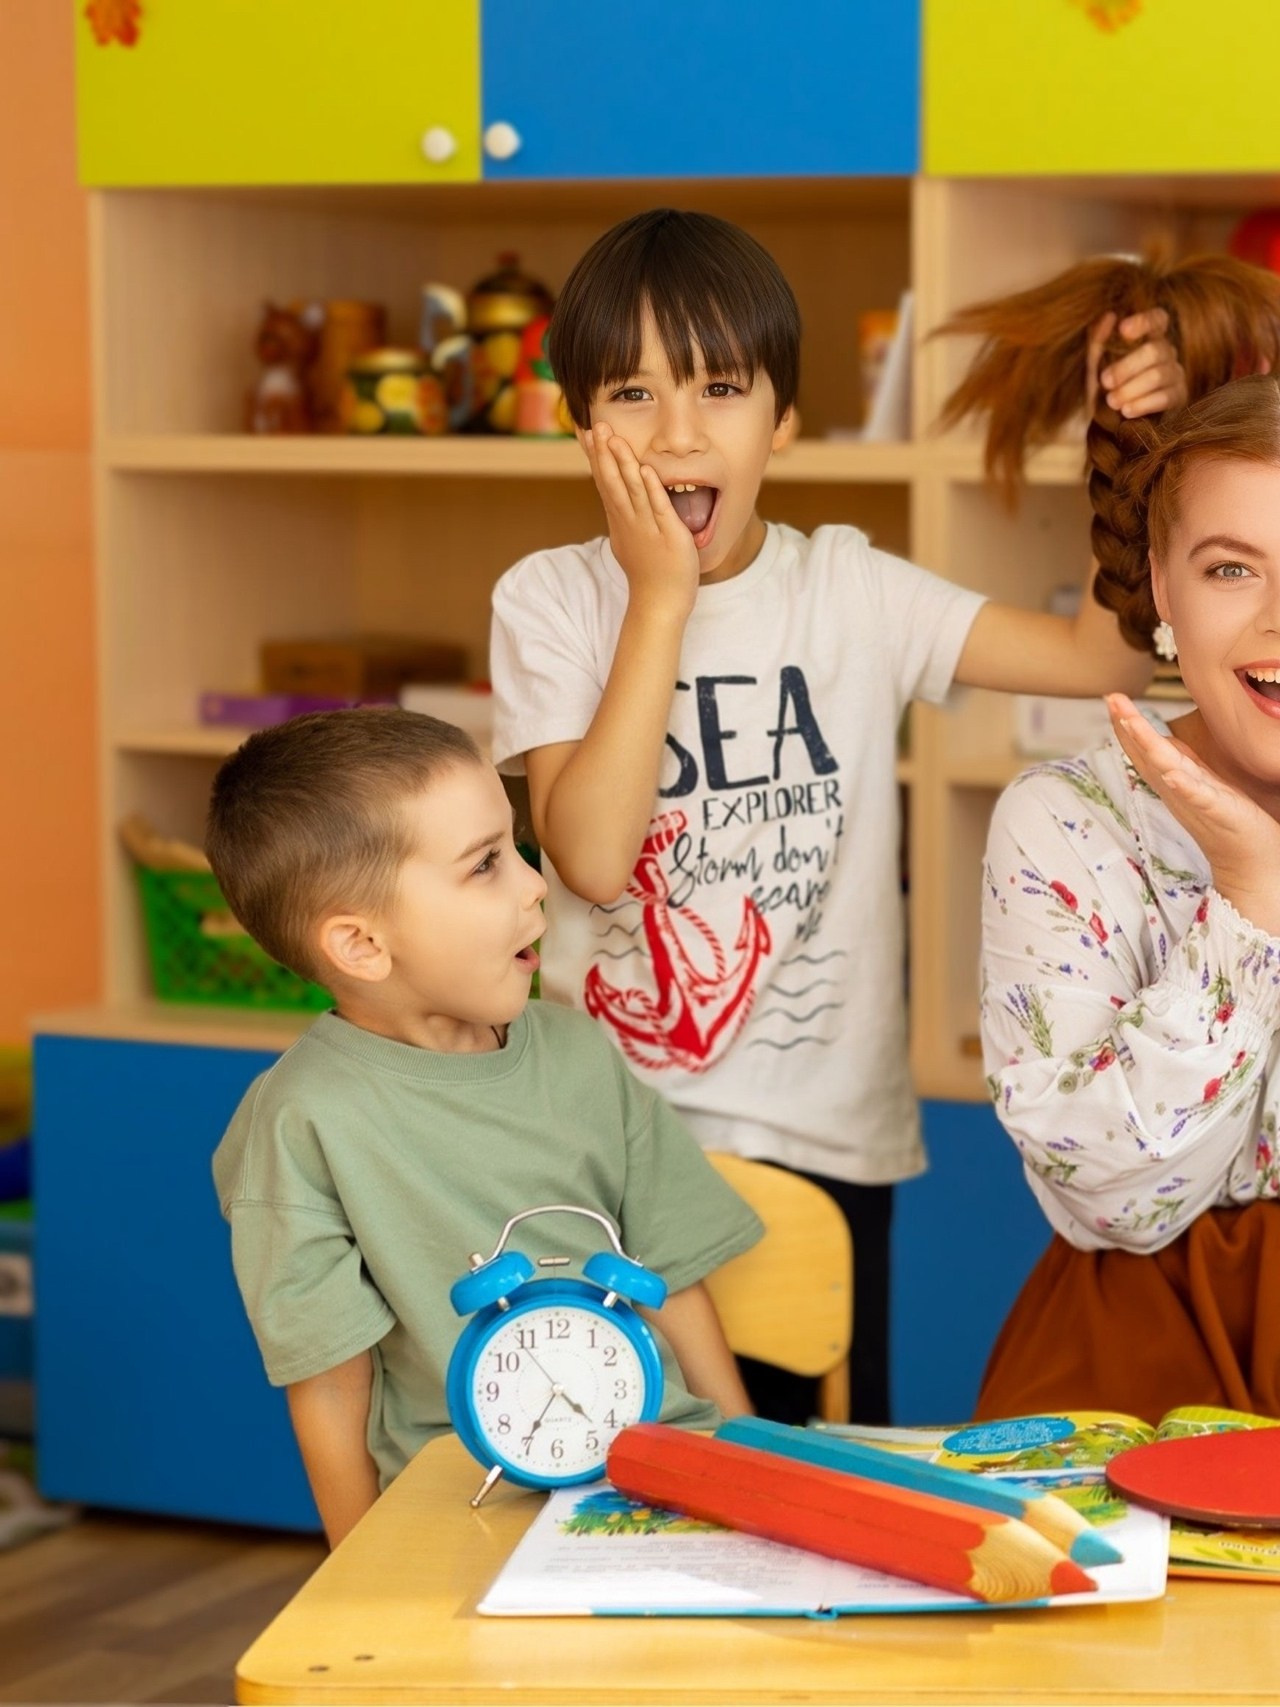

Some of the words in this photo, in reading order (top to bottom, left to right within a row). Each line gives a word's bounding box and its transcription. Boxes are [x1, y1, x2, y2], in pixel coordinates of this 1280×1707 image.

[702, 778, 842, 832] EXPLORER
[667, 831, 764, 909] Storm
[773, 814, 844, 873] don't
[517, 1328, 538, 1349] 11
[545, 1319, 570, 1340] 12
[588, 1328, 598, 1349] 1
[495, 1351, 520, 1373] 10
[604, 1346, 617, 1367] 2
[486, 1381, 499, 1401] 9
[614, 1379, 627, 1399] 3
[498, 1413, 511, 1434] 8
[604, 1408, 618, 1428] 4
[521, 1436, 534, 1456] 7
[550, 1438, 564, 1459] 6
[586, 1430, 599, 1450] 5
